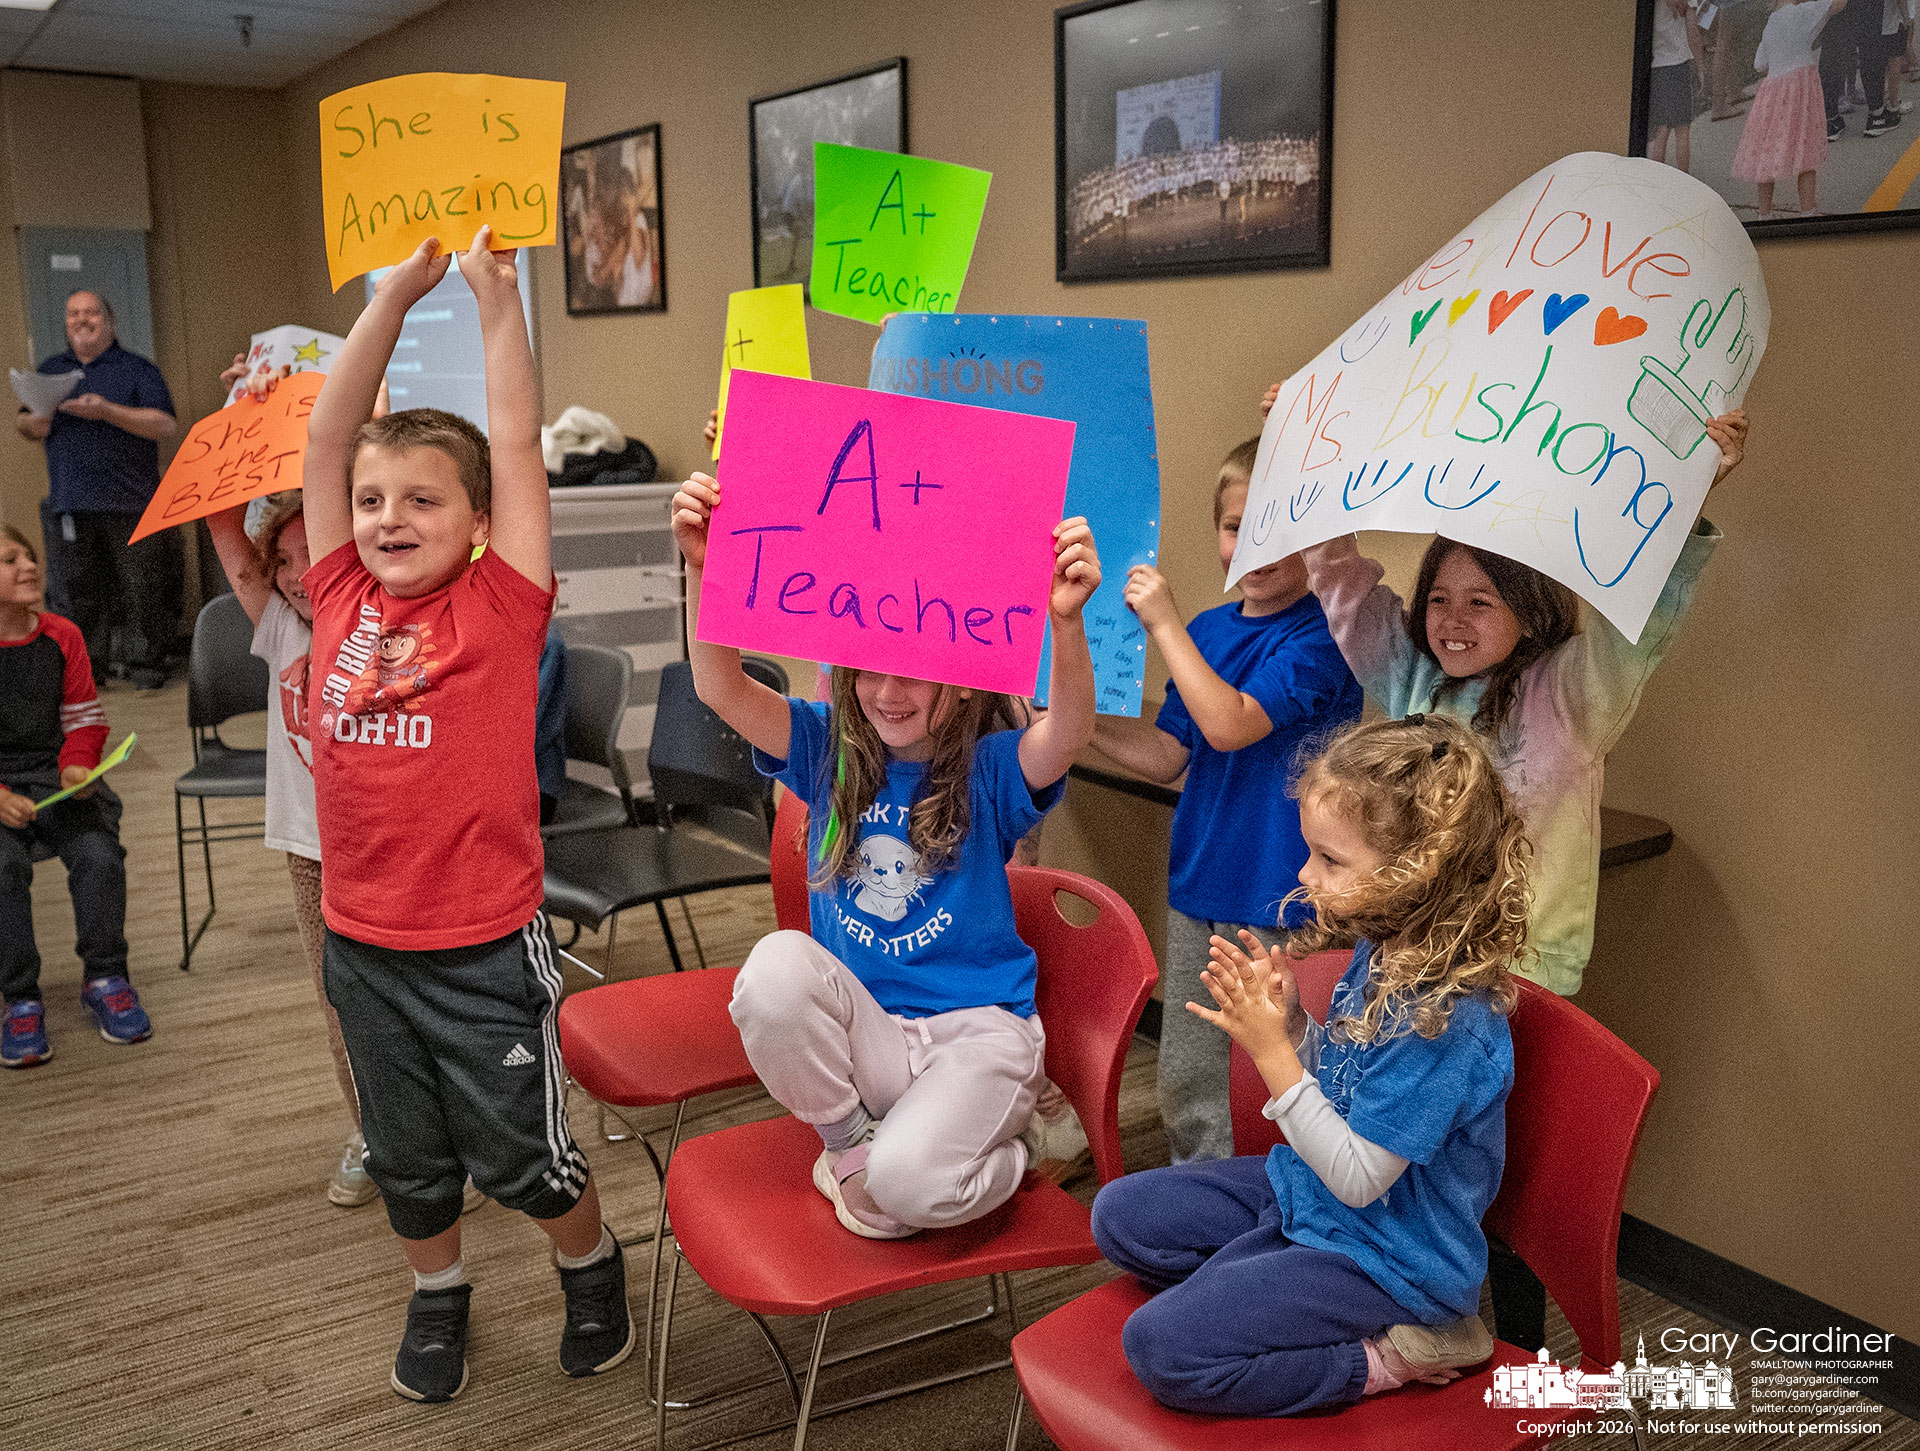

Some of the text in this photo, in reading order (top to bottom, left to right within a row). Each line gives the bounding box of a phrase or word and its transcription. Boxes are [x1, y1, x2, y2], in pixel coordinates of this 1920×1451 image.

[334, 99, 520, 157] She is
[339, 174, 548, 256] Amazing
[870, 169, 936, 235] A+
[1505, 174, 1691, 303] love
[826, 238, 951, 314] Teacher
[183, 394, 317, 464] She is
[213, 444, 269, 476] the
[1264, 337, 1674, 588] Ms. Bushong
[162, 450, 300, 519] BEST
[817, 418, 944, 532] A+
[731, 525, 1035, 646] Teacher
[322, 673, 351, 708] GO
[335, 711, 432, 749] OH-IO
[858, 802, 891, 824] RK
